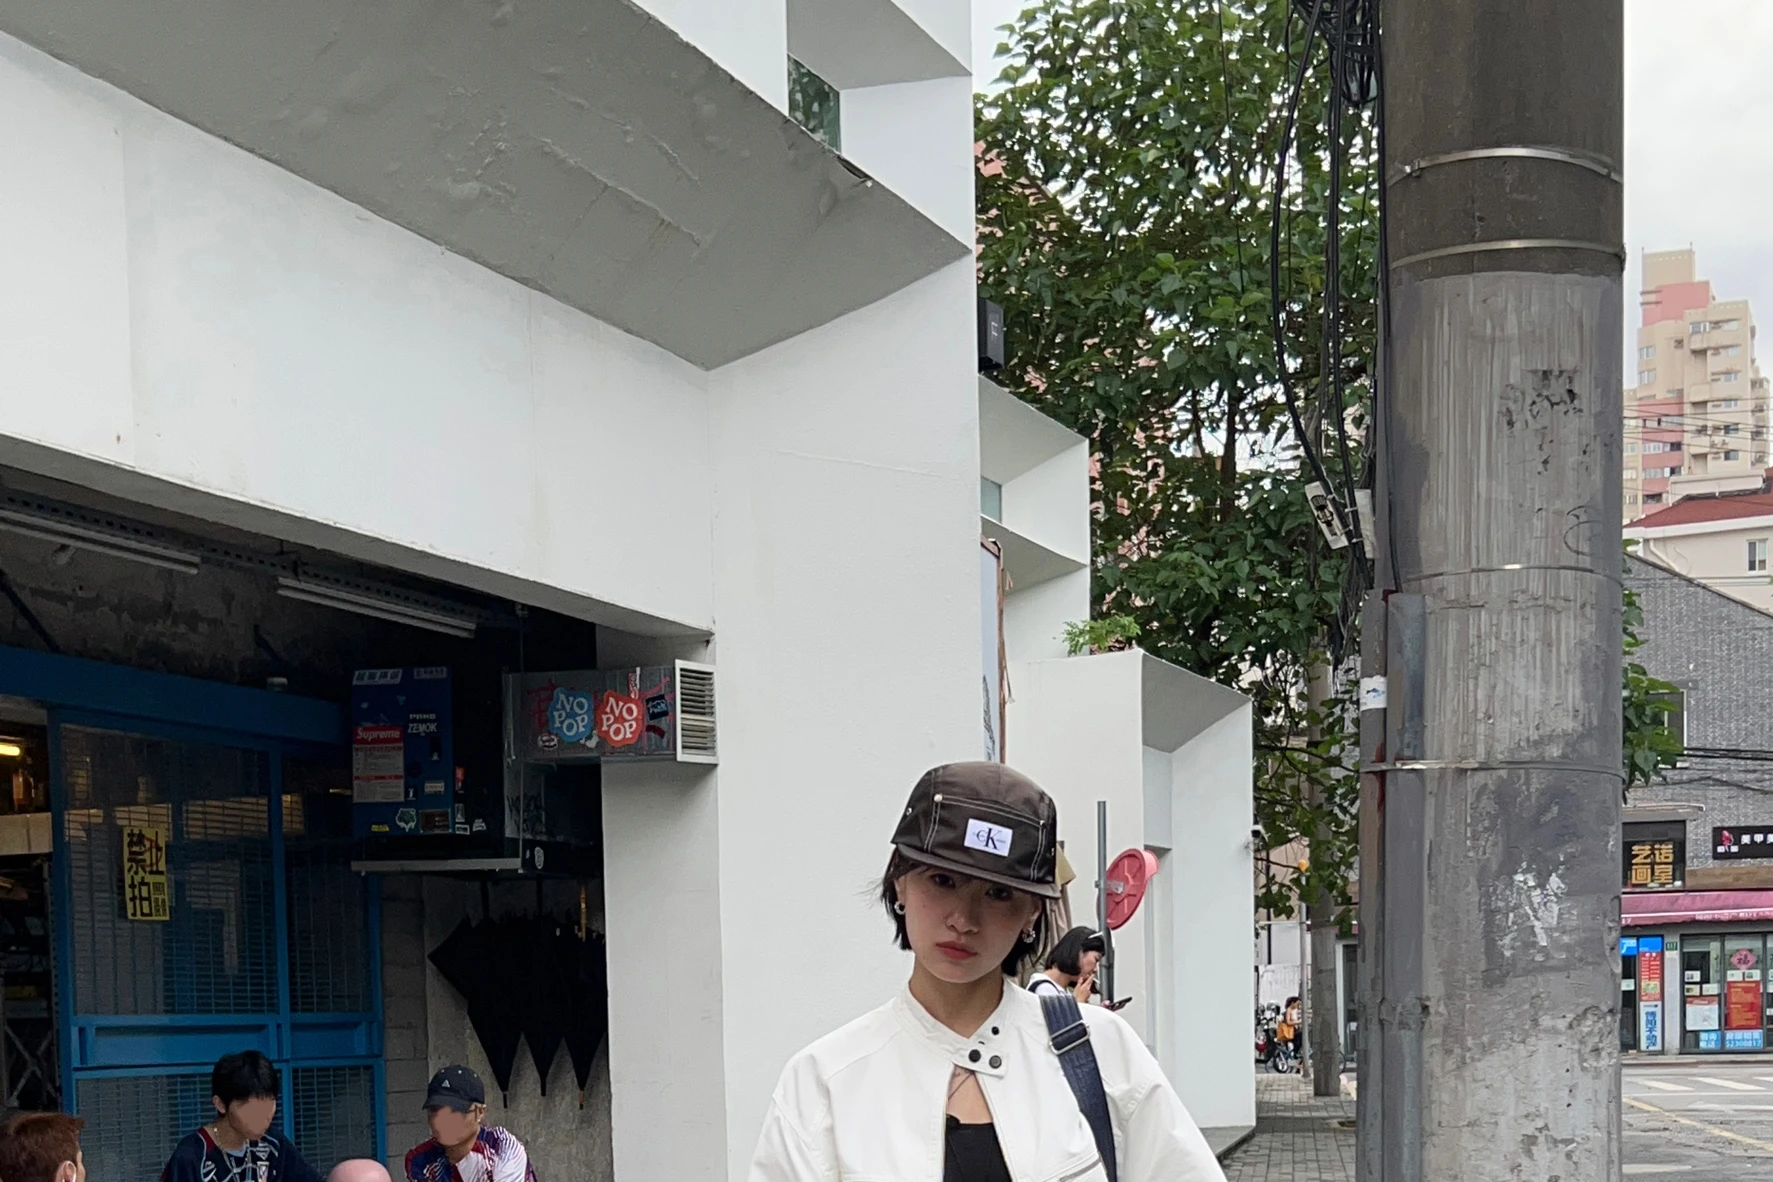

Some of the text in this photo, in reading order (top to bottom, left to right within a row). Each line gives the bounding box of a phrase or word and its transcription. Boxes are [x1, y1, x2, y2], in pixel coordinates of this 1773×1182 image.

[556, 693, 588, 715] NO
[605, 697, 638, 720] NO
[356, 727, 401, 742] Supreme
[553, 711, 588, 737] POP
[601, 714, 637, 741] POP
[1631, 864, 1673, 884] 画室
